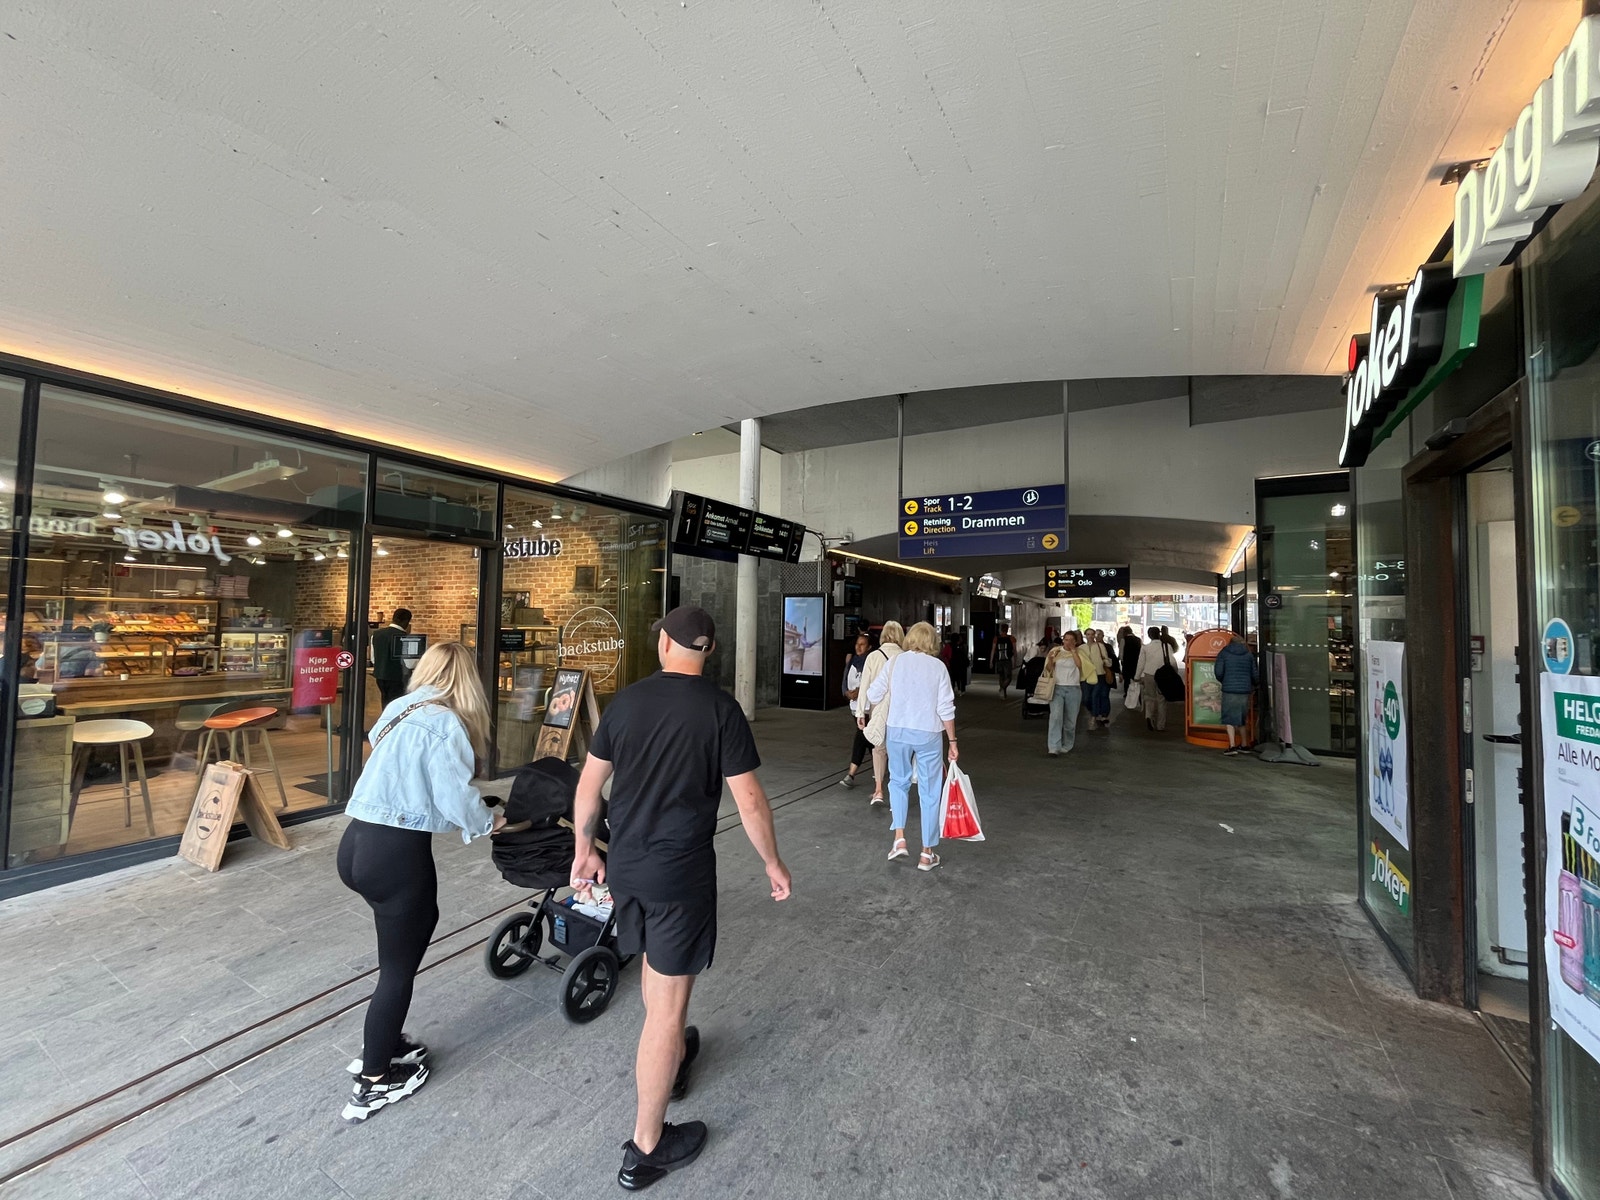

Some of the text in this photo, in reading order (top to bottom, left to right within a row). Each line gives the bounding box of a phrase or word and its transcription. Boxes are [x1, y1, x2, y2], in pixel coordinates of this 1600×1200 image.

[1453, 13, 1600, 279] Døgn
[1338, 268, 1423, 467] joker
[924, 495, 973, 511] Spor 1-2
[924, 505, 942, 513] Track
[686, 519, 691, 534] 1
[923, 517, 951, 526] Retning
[962, 515, 1025, 529] Drammen
[923, 525, 956, 534] Direction
[791, 543, 799, 557] 2
[923, 539, 939, 547] Heis
[923, 547, 935, 555] Lift
[1070, 570, 1084, 578] 3-4
[558, 637, 625, 657] backstube
[308, 657, 328, 665] Kjøp
[300, 666, 334, 675] billetter
[1558, 742, 1578, 765] Alle
[1574, 806, 1585, 836] 3
[1371, 845, 1406, 906] joker
